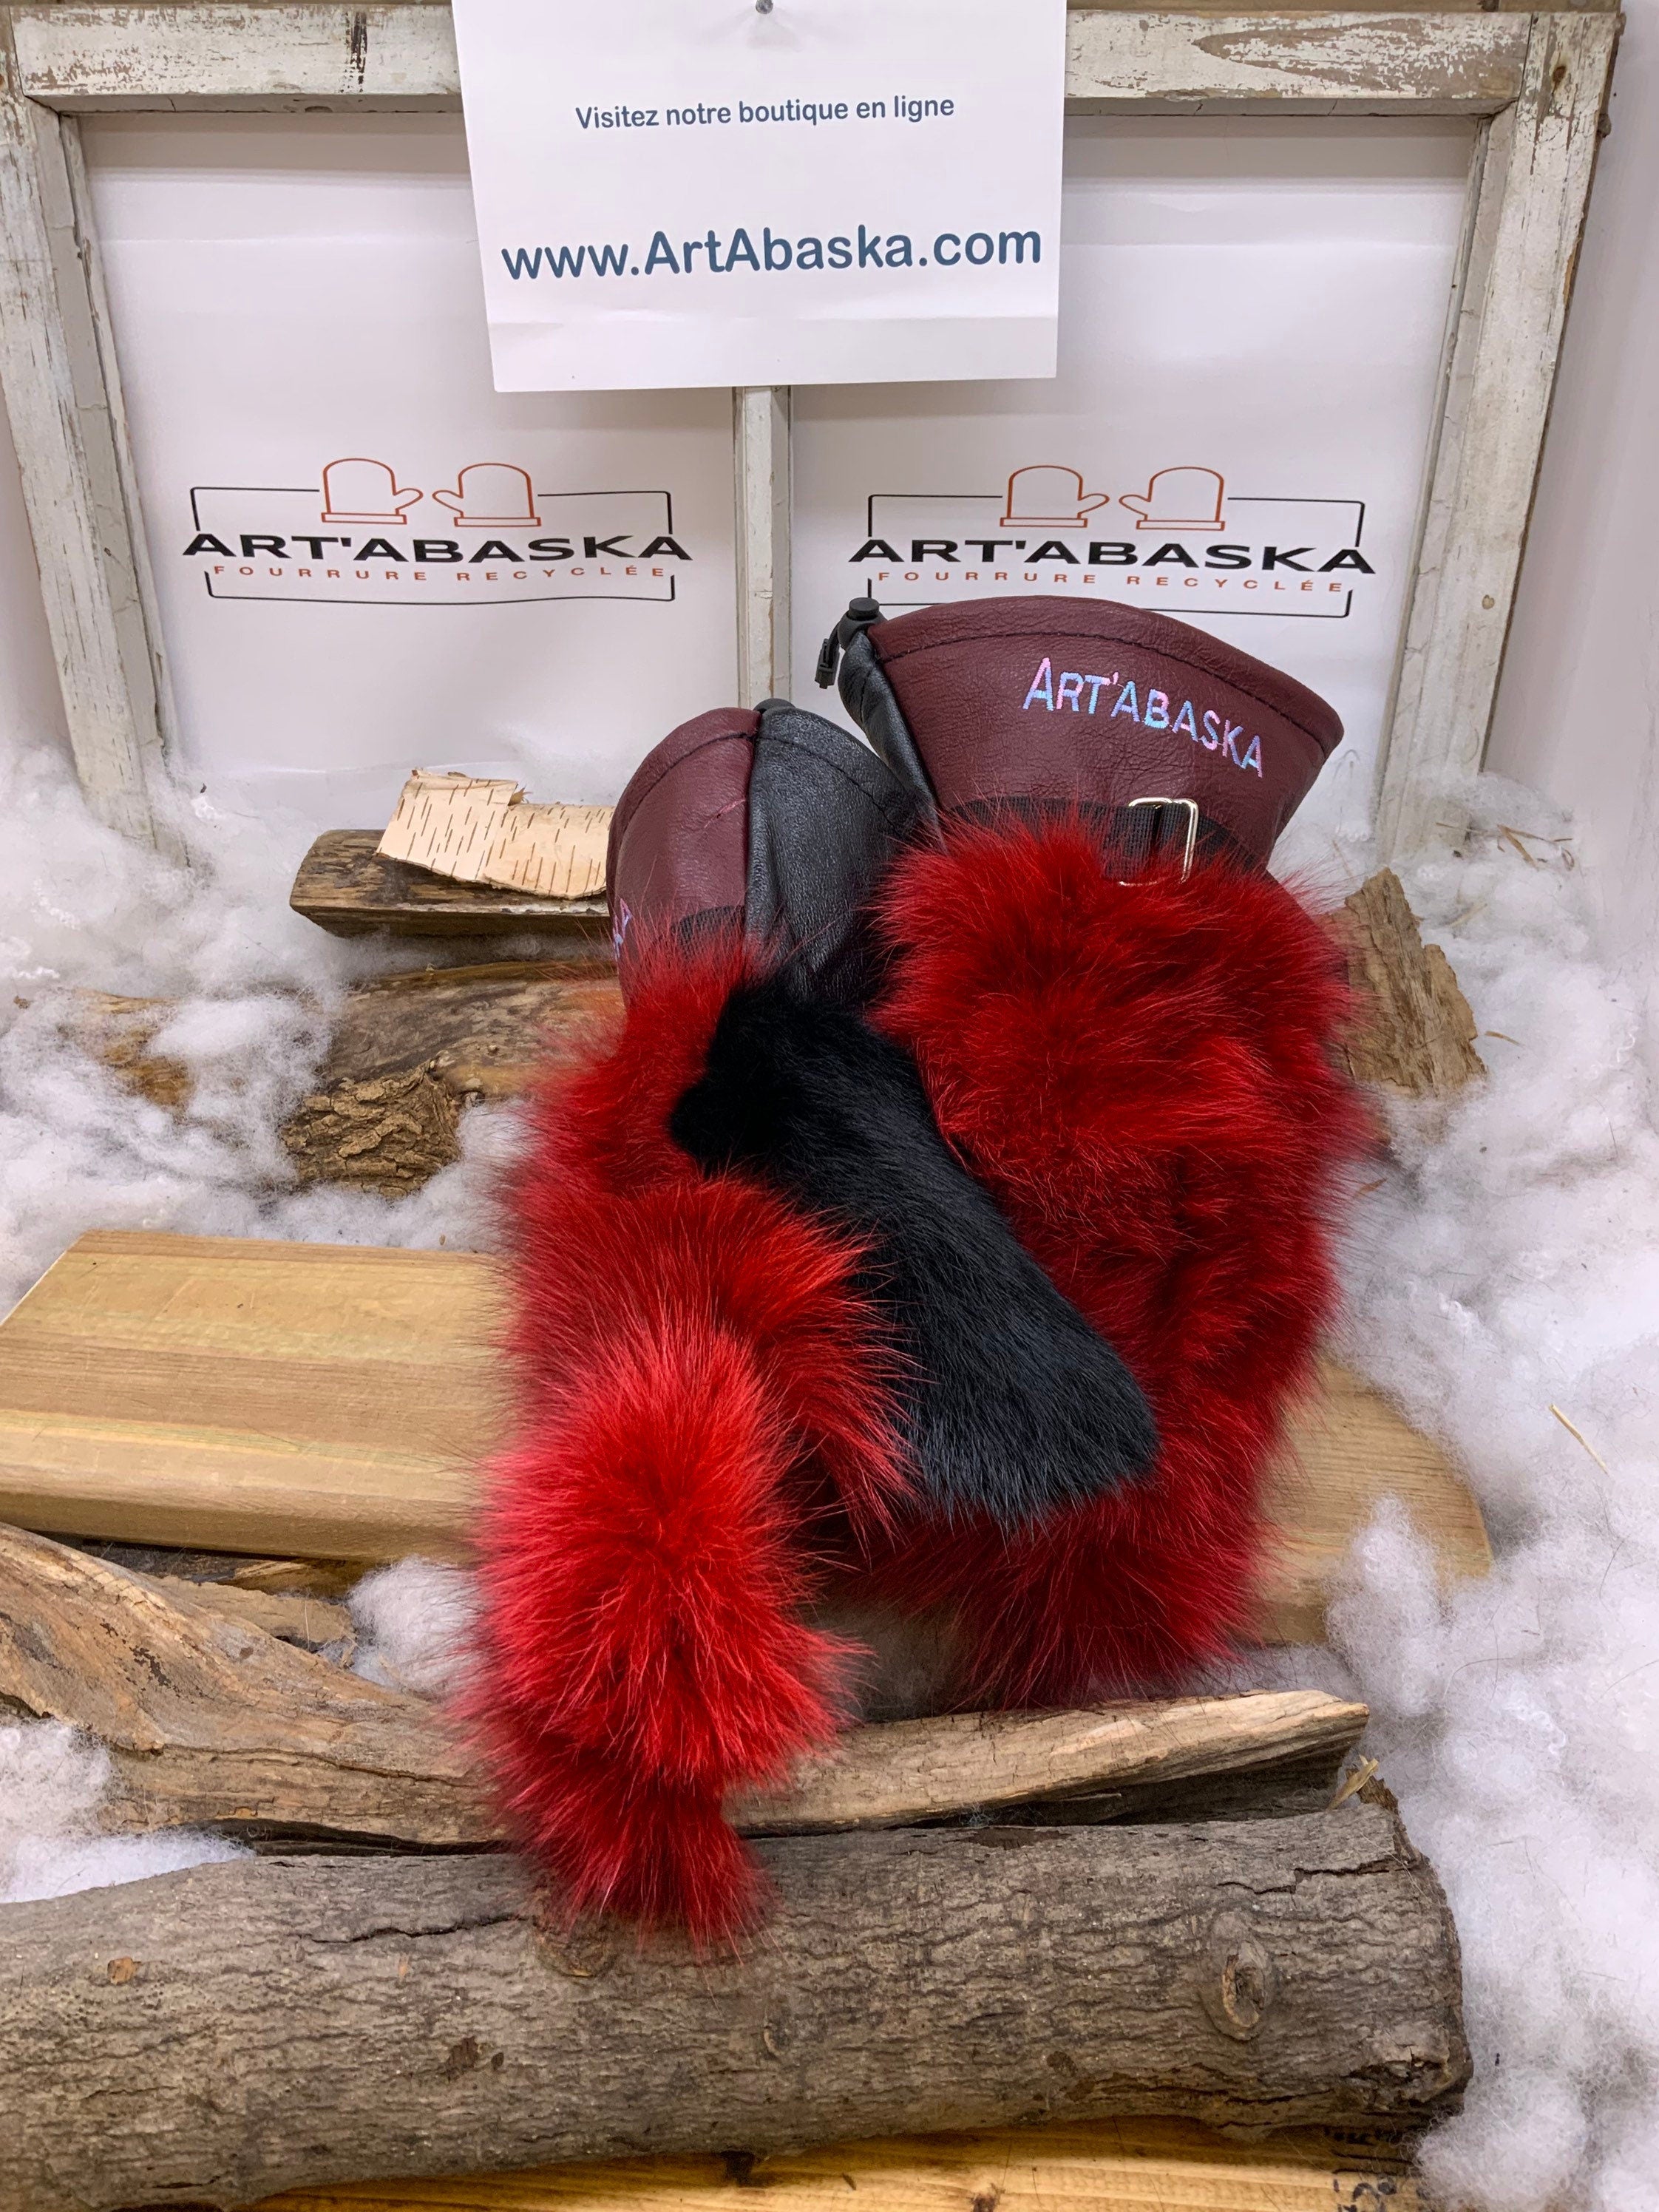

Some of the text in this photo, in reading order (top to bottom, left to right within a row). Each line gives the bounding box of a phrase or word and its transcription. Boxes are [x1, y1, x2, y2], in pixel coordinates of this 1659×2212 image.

[575, 95, 955, 129] Visitez notre boutique en ligne
[501, 224, 1042, 280] www.ArtAbaska.com
[183, 532, 693, 563] ART'ABASKA
[848, 538, 1376, 574] ART'ABASKA
[213, 565, 664, 582] FOURRURE RECYCLÉE
[878, 571, 1342, 592] FOURRURE RECYCLÉE
[1022, 657, 1263, 778] ART'ABASKA
